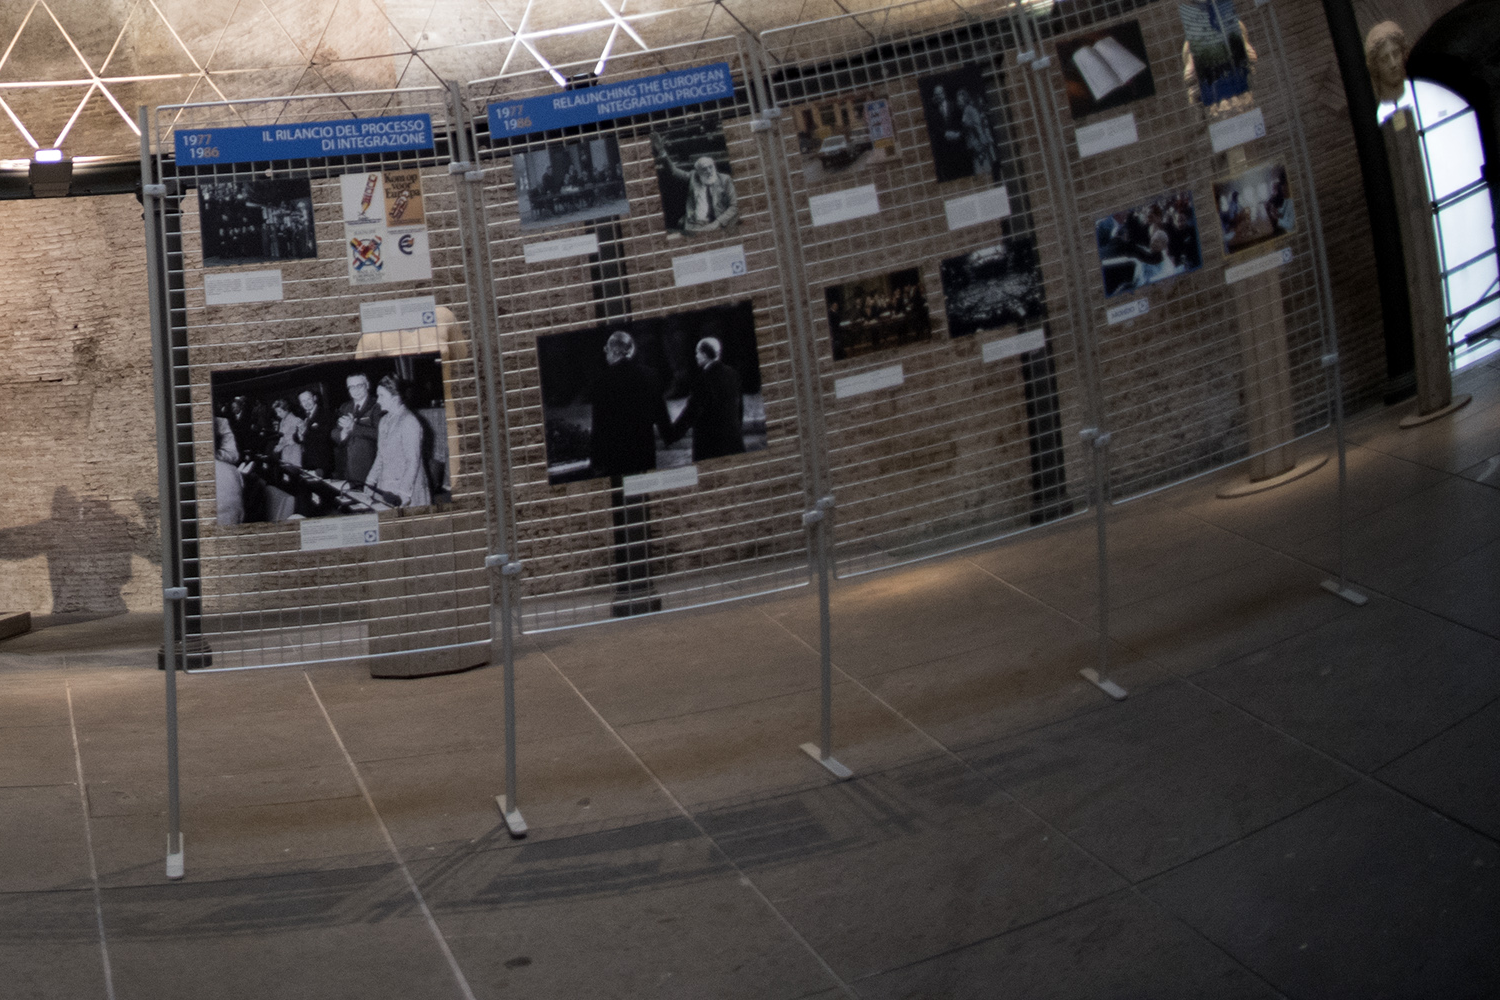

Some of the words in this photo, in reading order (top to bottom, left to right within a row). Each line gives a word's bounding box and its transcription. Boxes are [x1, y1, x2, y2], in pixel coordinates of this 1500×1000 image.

[552, 86, 637, 110] RELAUNCHING
[637, 81, 661, 96] THE
[662, 69, 724, 90] EUROPEAN
[597, 93, 674, 115] INTEGRATION
[675, 81, 727, 101] PROCESS
[496, 104, 523, 119] 1977
[262, 130, 273, 142] IL
[276, 125, 333, 141] RILANCIO
[336, 123, 359, 137] DEL
[361, 119, 425, 135] PROCESSO
[504, 116, 533, 131] 1986
[183, 133, 211, 146] 1977
[322, 139, 335, 151] DI
[337, 132, 426, 149] INTEGRAZIONE
[189, 147, 219, 159] 1986
[385, 188, 421, 199] Eurpa
